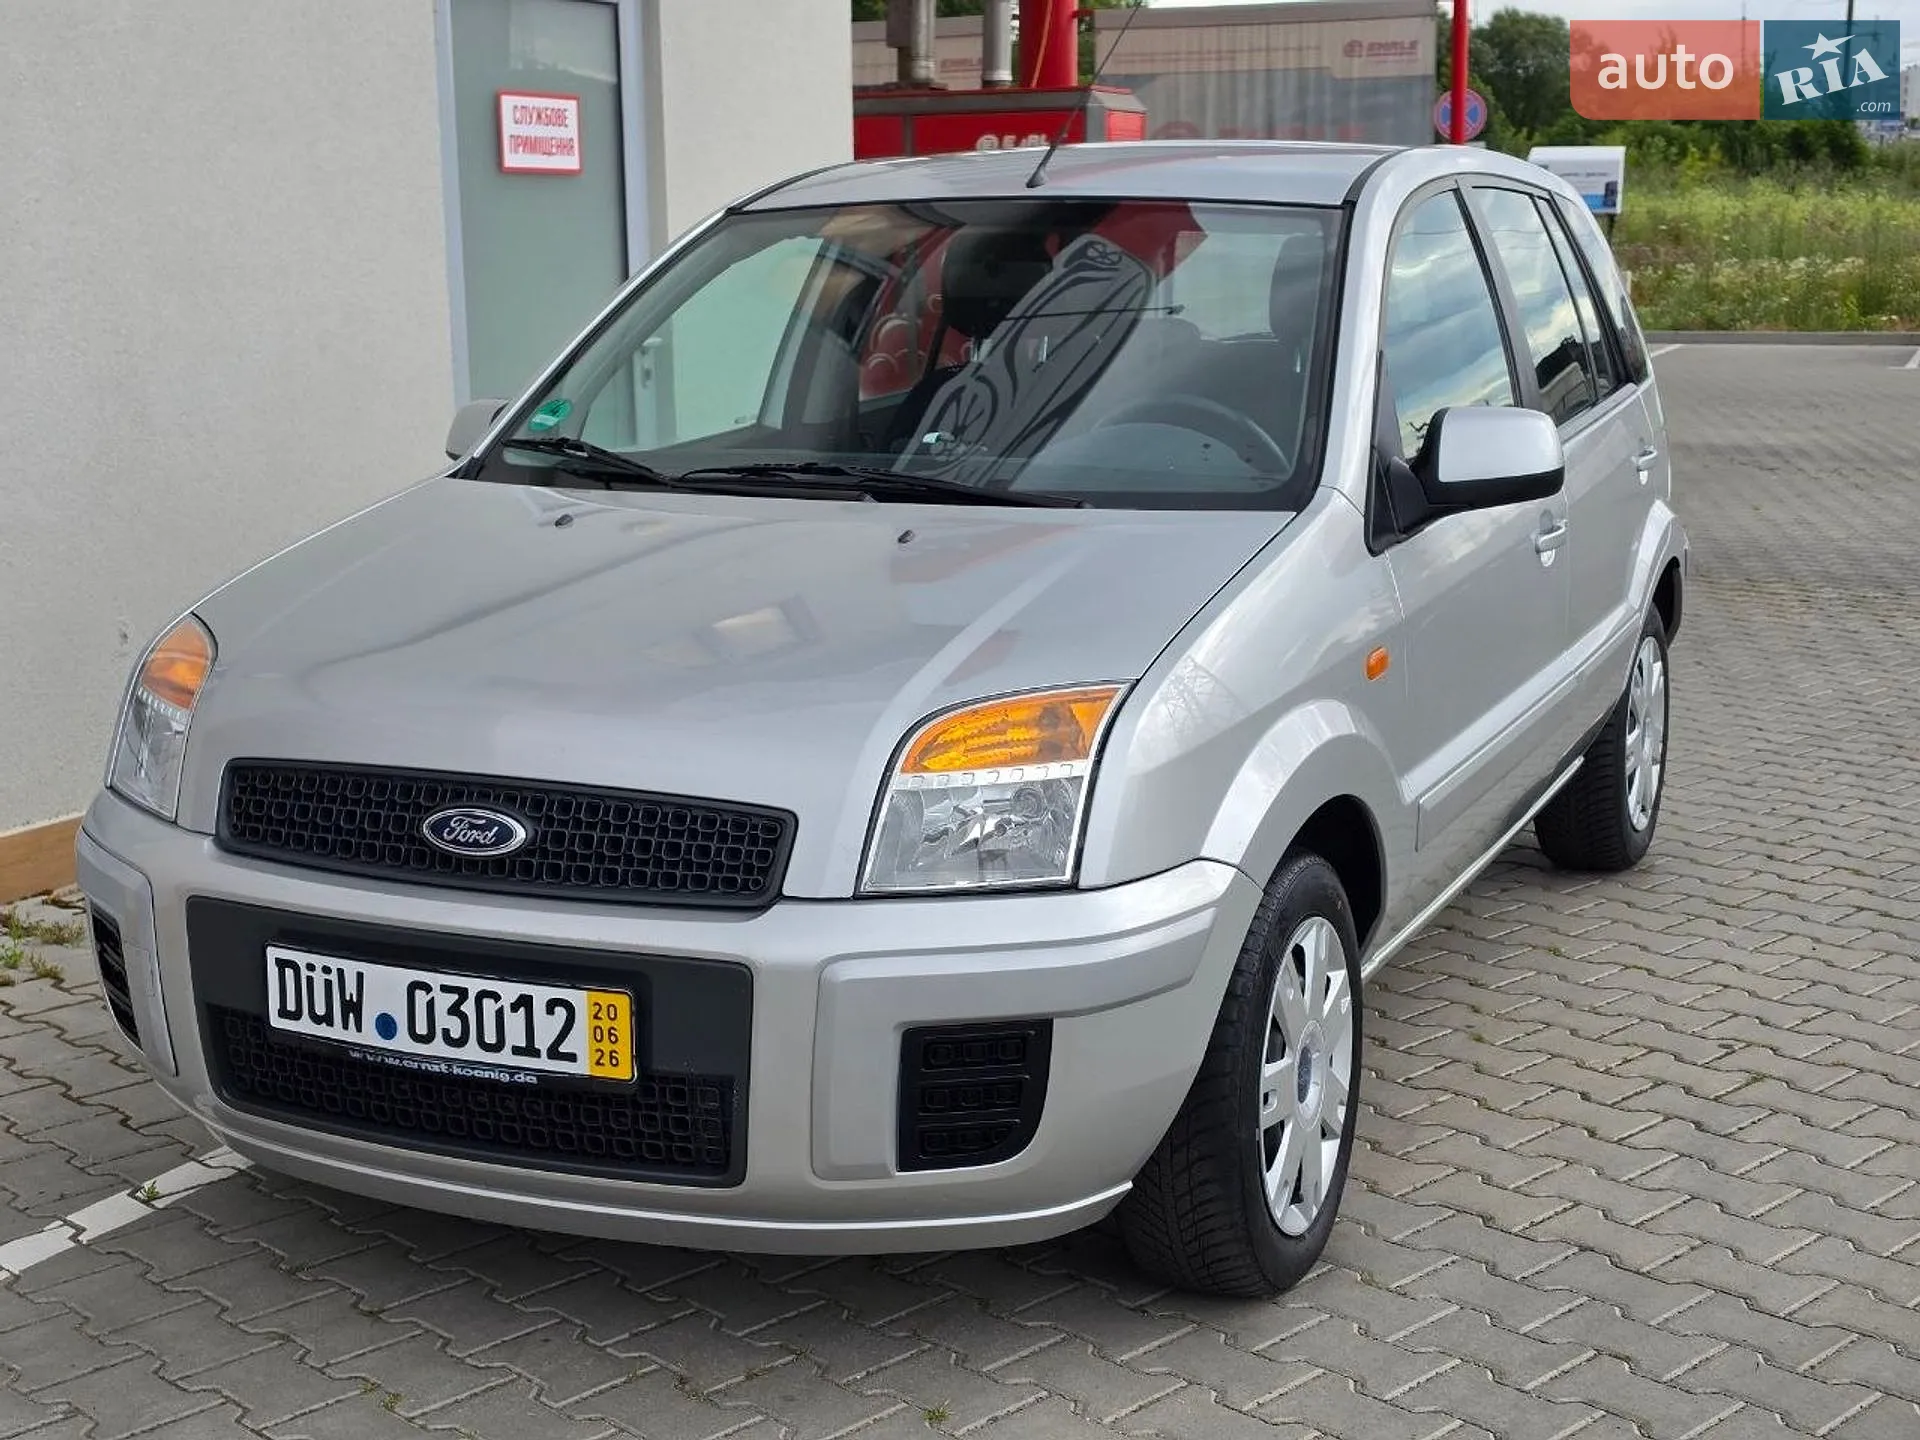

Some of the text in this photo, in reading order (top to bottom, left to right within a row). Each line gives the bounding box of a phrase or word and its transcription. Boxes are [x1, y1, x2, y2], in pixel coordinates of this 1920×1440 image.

[512, 104, 569, 128] СЛУЖБОВЕ
[509, 134, 575, 157] ПРИМІЩЕННЯ
[443, 816, 499, 844] Ford
[406, 980, 578, 1063] 03012
[592, 1002, 618, 1022] 20
[593, 1025, 619, 1044] 06
[594, 1048, 620, 1067] 26
